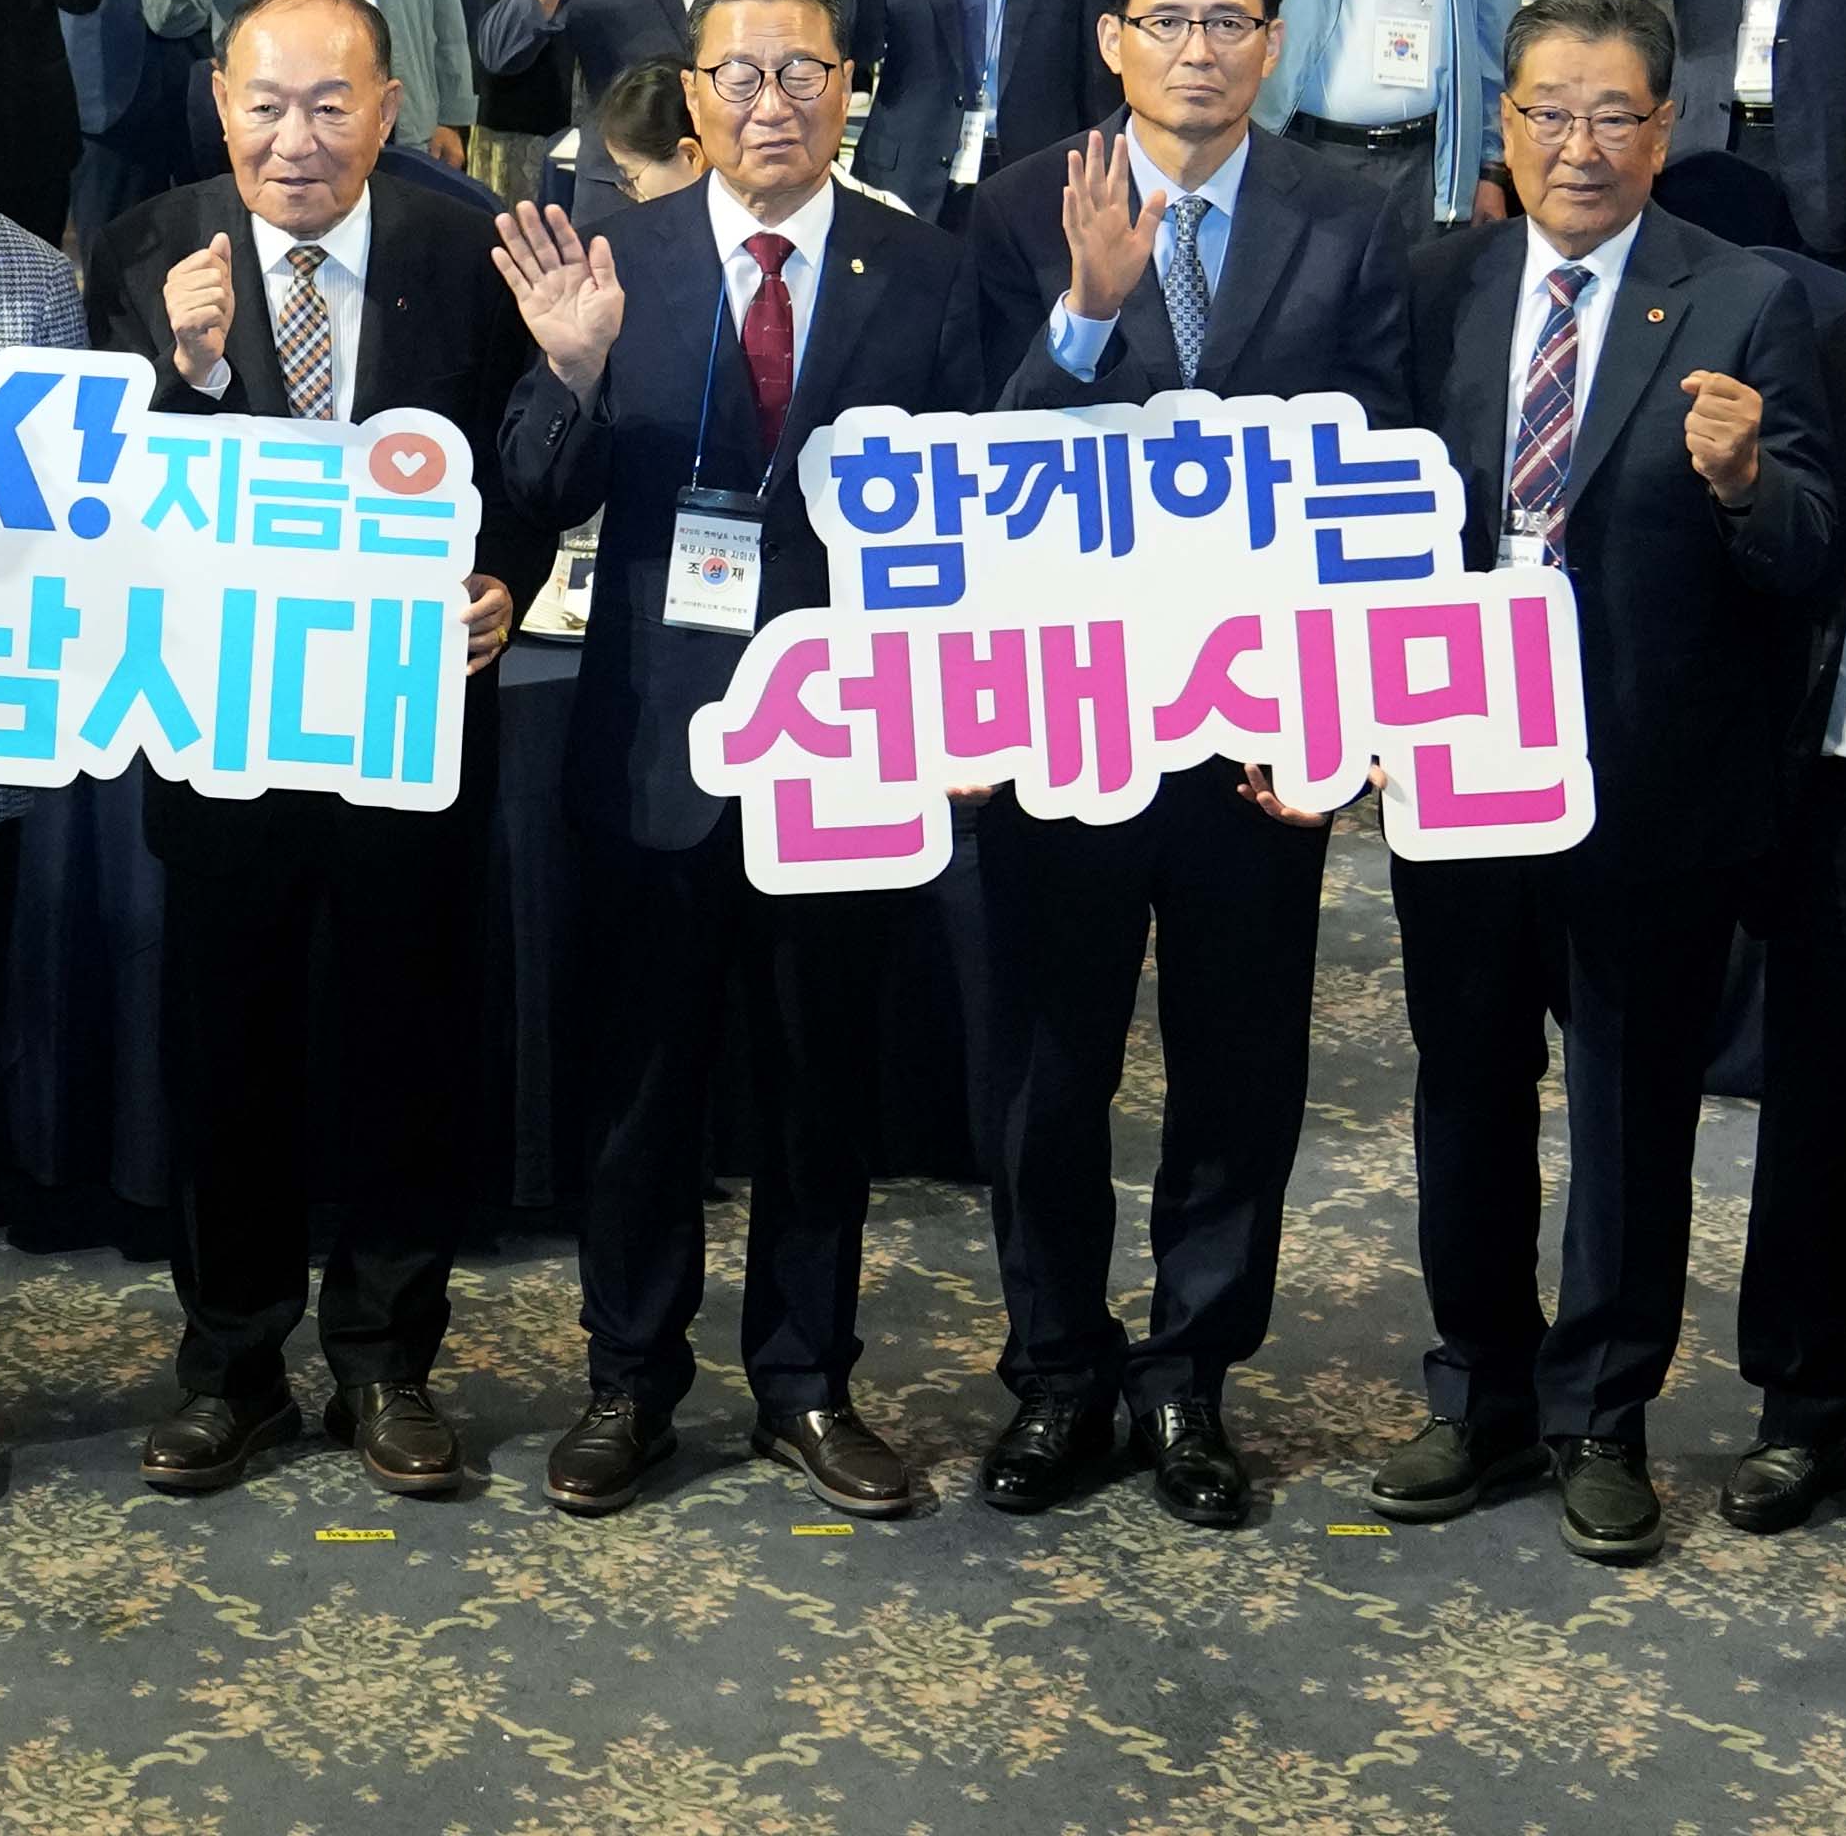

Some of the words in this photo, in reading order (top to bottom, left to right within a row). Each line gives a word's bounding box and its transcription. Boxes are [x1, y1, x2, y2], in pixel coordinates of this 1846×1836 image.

[143, 431, 456, 558] 지금은
[830, 420, 1436, 611] 함께하는
[723, 596, 1567, 863] 선배시민
